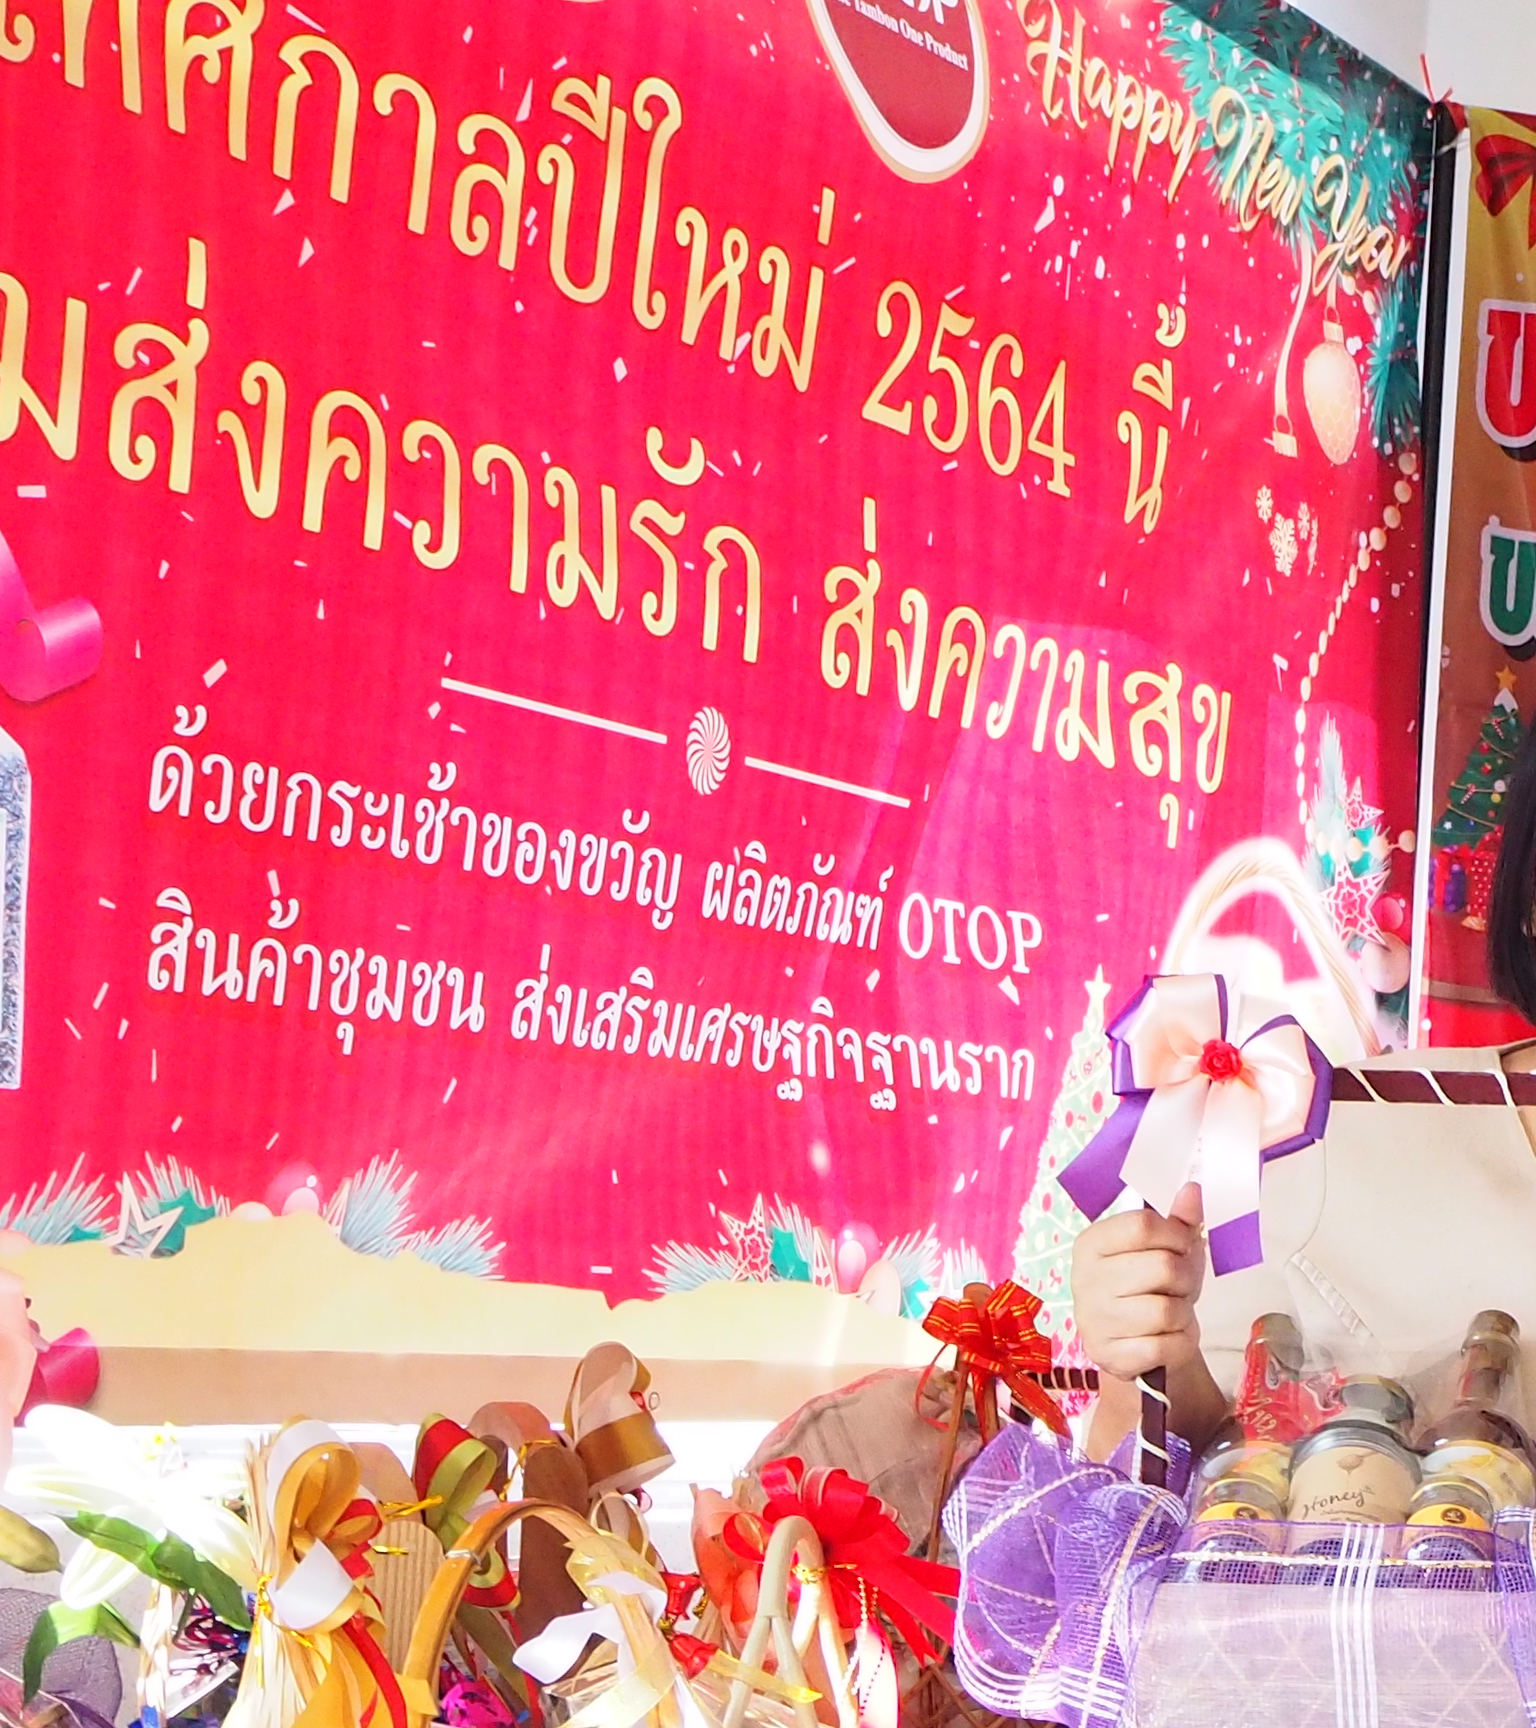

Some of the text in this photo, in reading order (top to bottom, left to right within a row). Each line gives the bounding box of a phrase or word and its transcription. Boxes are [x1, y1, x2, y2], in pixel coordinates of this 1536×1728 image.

[924, 31, 968, 71] Product
[1016, 0, 1413, 296] Happy New Year
[861, 280, 1076, 498] 2564
[1117, 301, 1187, 534] นี้
[819, 497, 1233, 850] ส่งความสุข
[148, 704, 1043, 976] ด้วยกระเช้าของขวัญ ผลิตภัณฑ์ OTOP
[147, 886, 1035, 1111] สินค้าชุมชน ส่งเสริมเศรษฐกิจฐานราก
